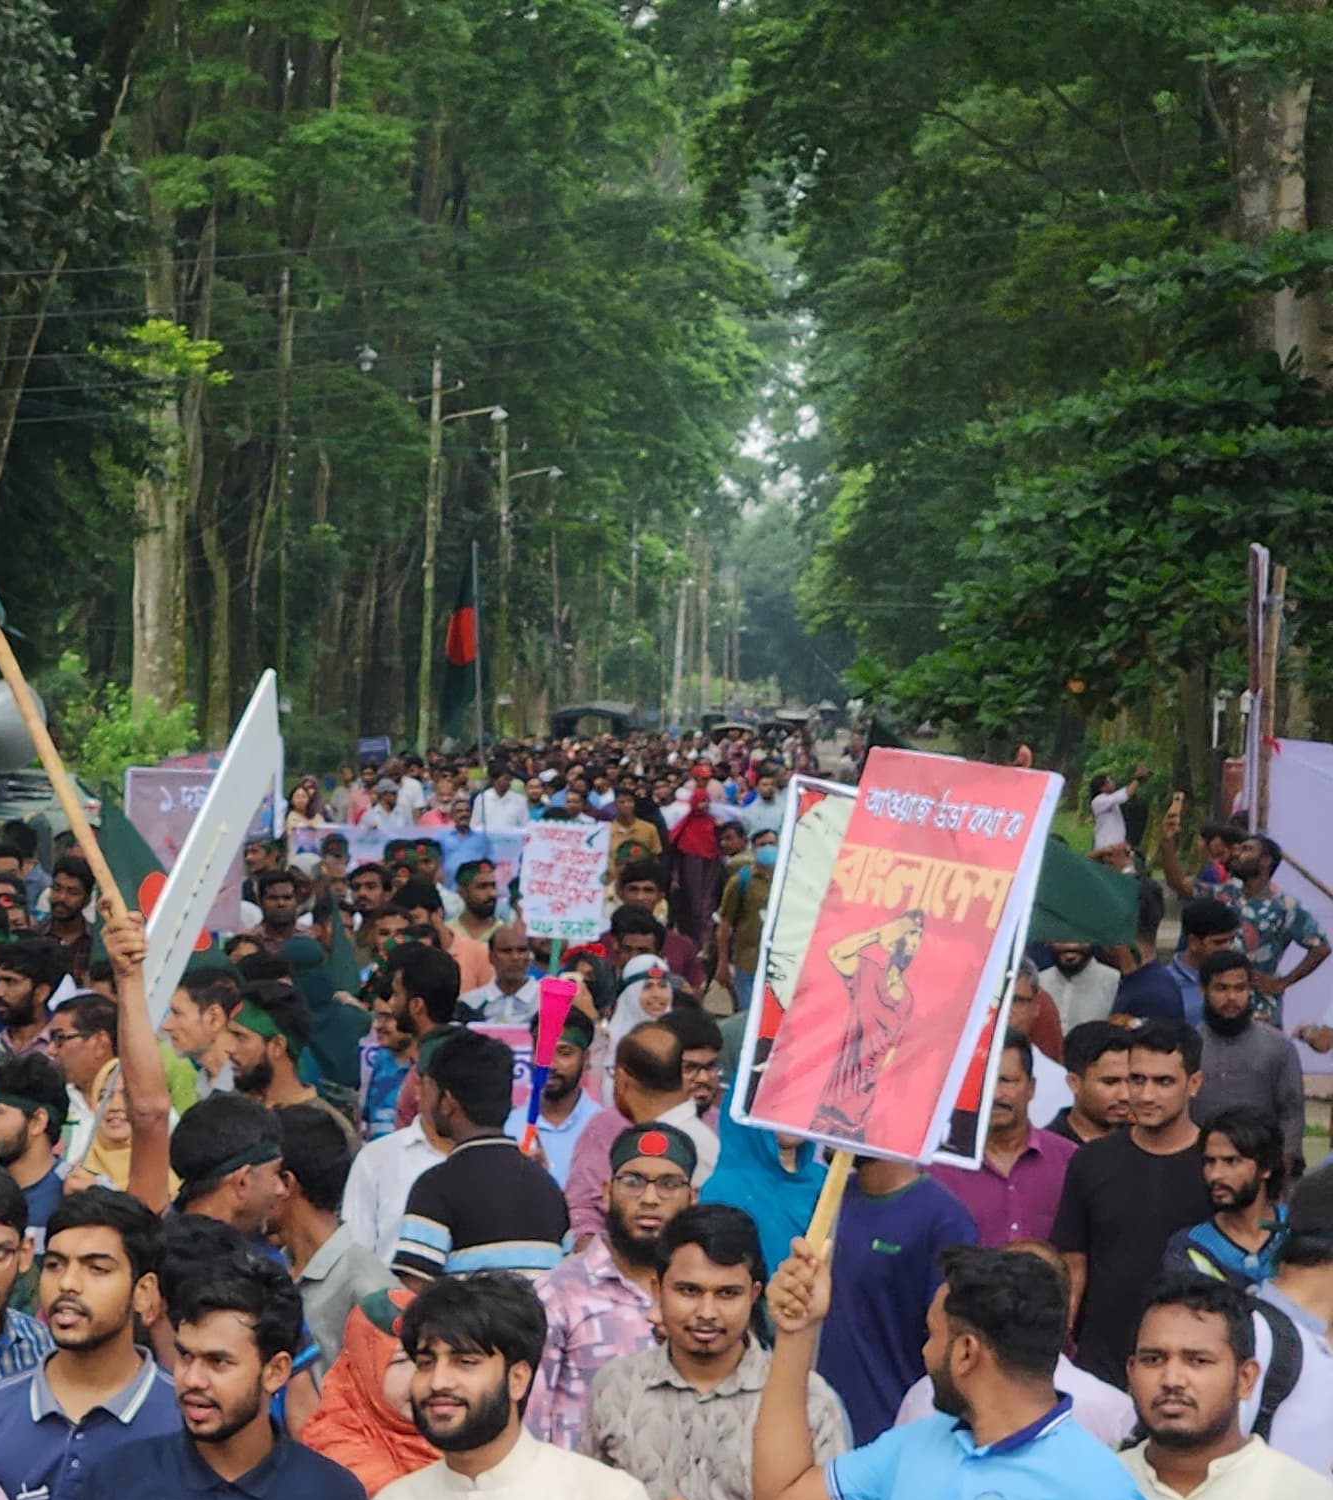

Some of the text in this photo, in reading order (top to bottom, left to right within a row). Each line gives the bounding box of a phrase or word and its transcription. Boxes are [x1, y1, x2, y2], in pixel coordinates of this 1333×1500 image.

[865, 786, 935, 826] আওয়াজ
[967, 803, 1005, 841] কথা
[1004, 810, 1026, 842] ক
[831, 842, 1016, 930] বাংলাদেশ
